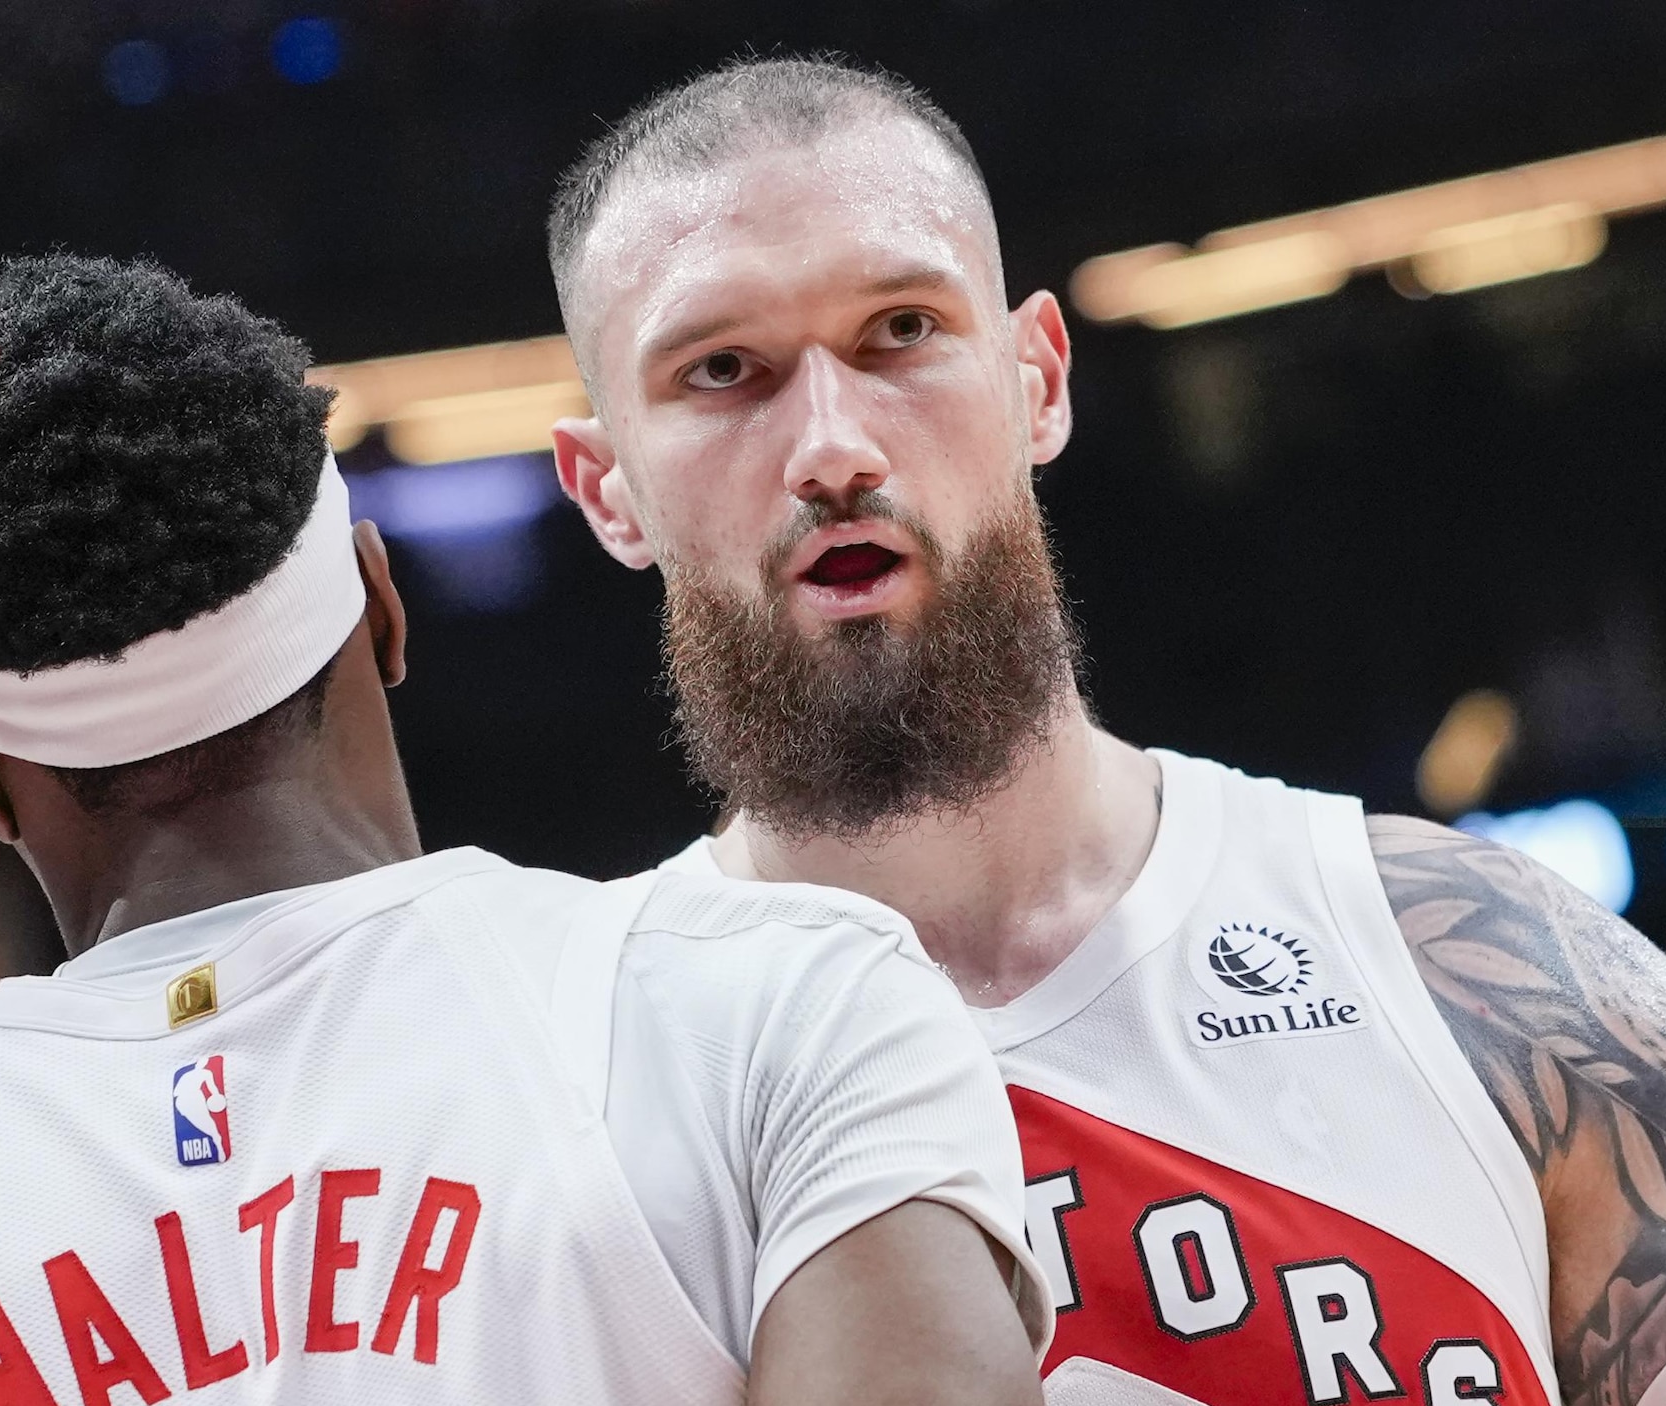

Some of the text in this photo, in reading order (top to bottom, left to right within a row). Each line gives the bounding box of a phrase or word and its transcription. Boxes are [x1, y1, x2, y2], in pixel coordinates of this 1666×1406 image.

[1197, 998, 1360, 1042] Sun Life
[183, 1138, 212, 1161] NBA
